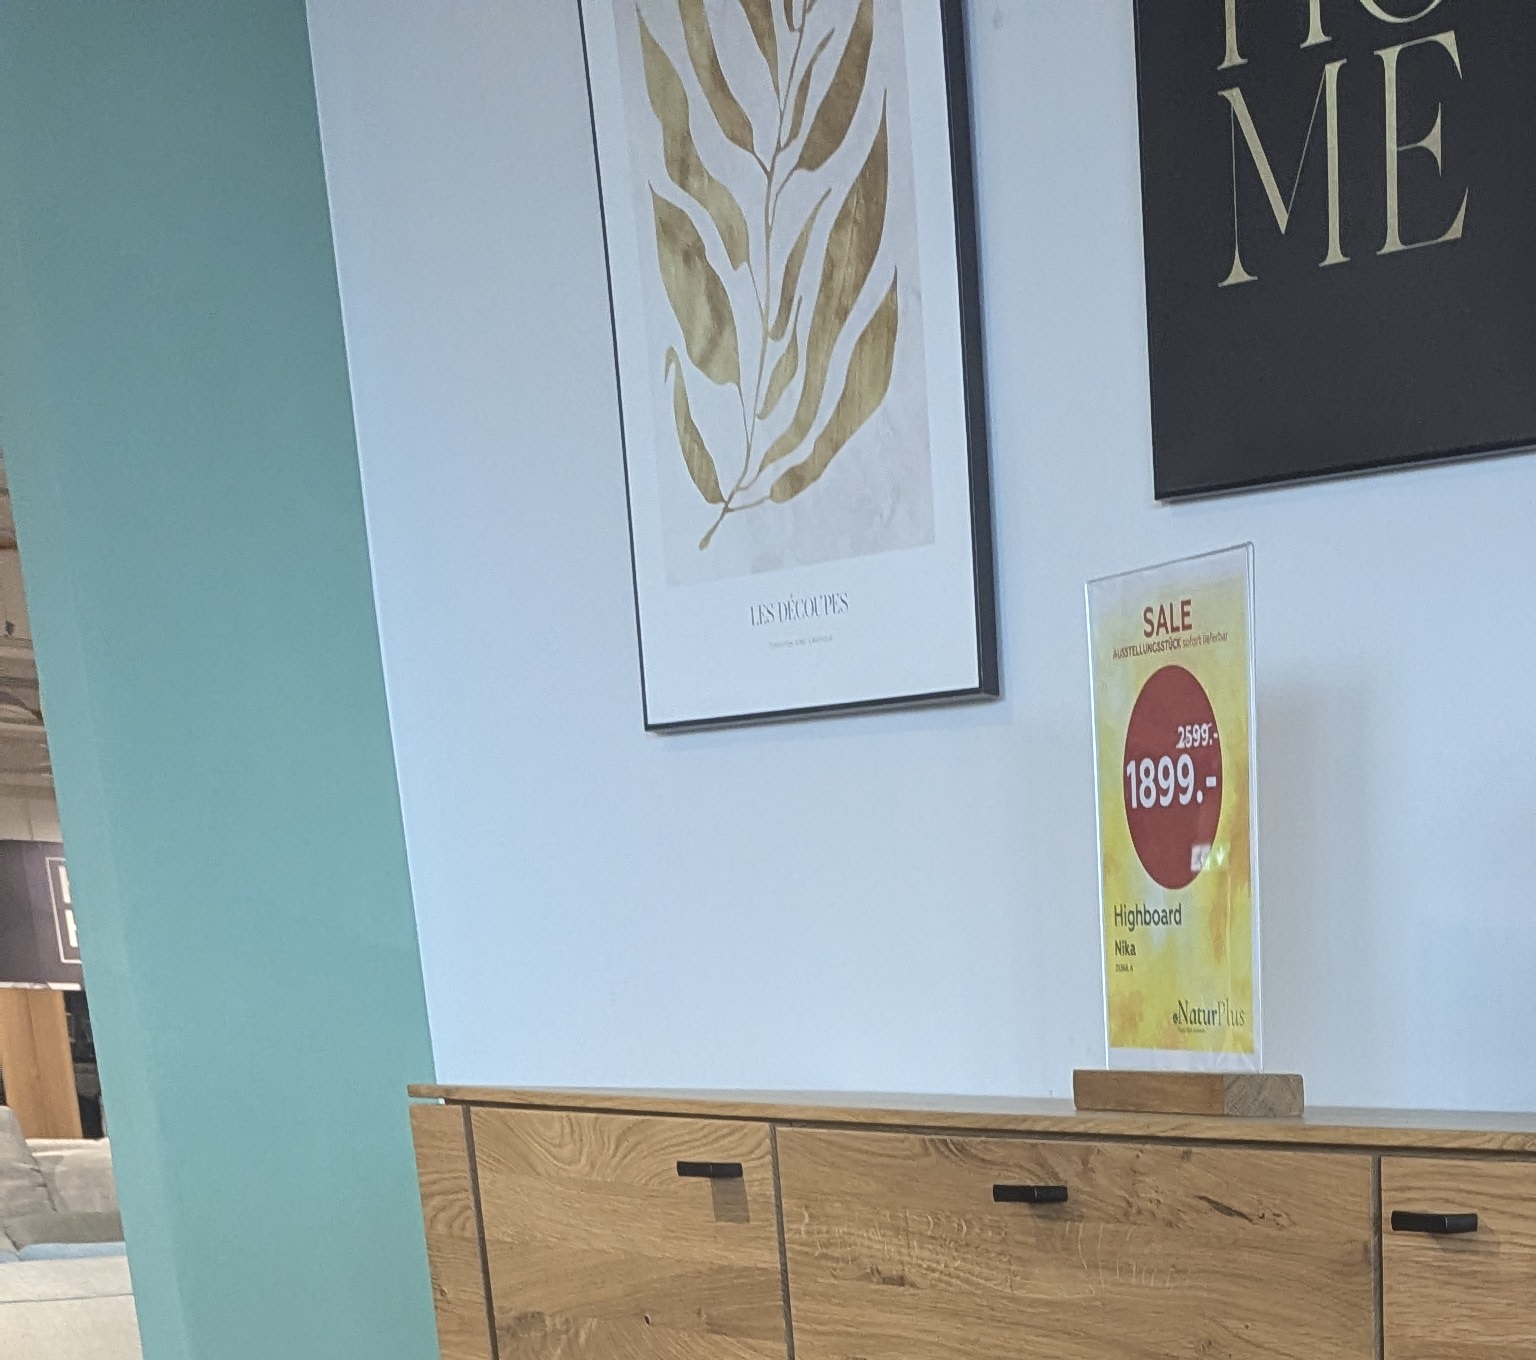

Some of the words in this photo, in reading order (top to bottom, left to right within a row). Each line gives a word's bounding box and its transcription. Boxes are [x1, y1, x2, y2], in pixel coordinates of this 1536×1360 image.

[1218, 30, 1468, 287] ME
[750, 603, 775, 626] LES
[778, 592, 849, 622] DÉCOUPES
[1143, 599, 1193, 638] SALE
[1126, 753, 1217, 809] 1899.-
[1113, 902, 1182, 932] Highboard
[1114, 939, 1137, 956] Nika
[1177, 998, 1245, 1027] NaturPlus
